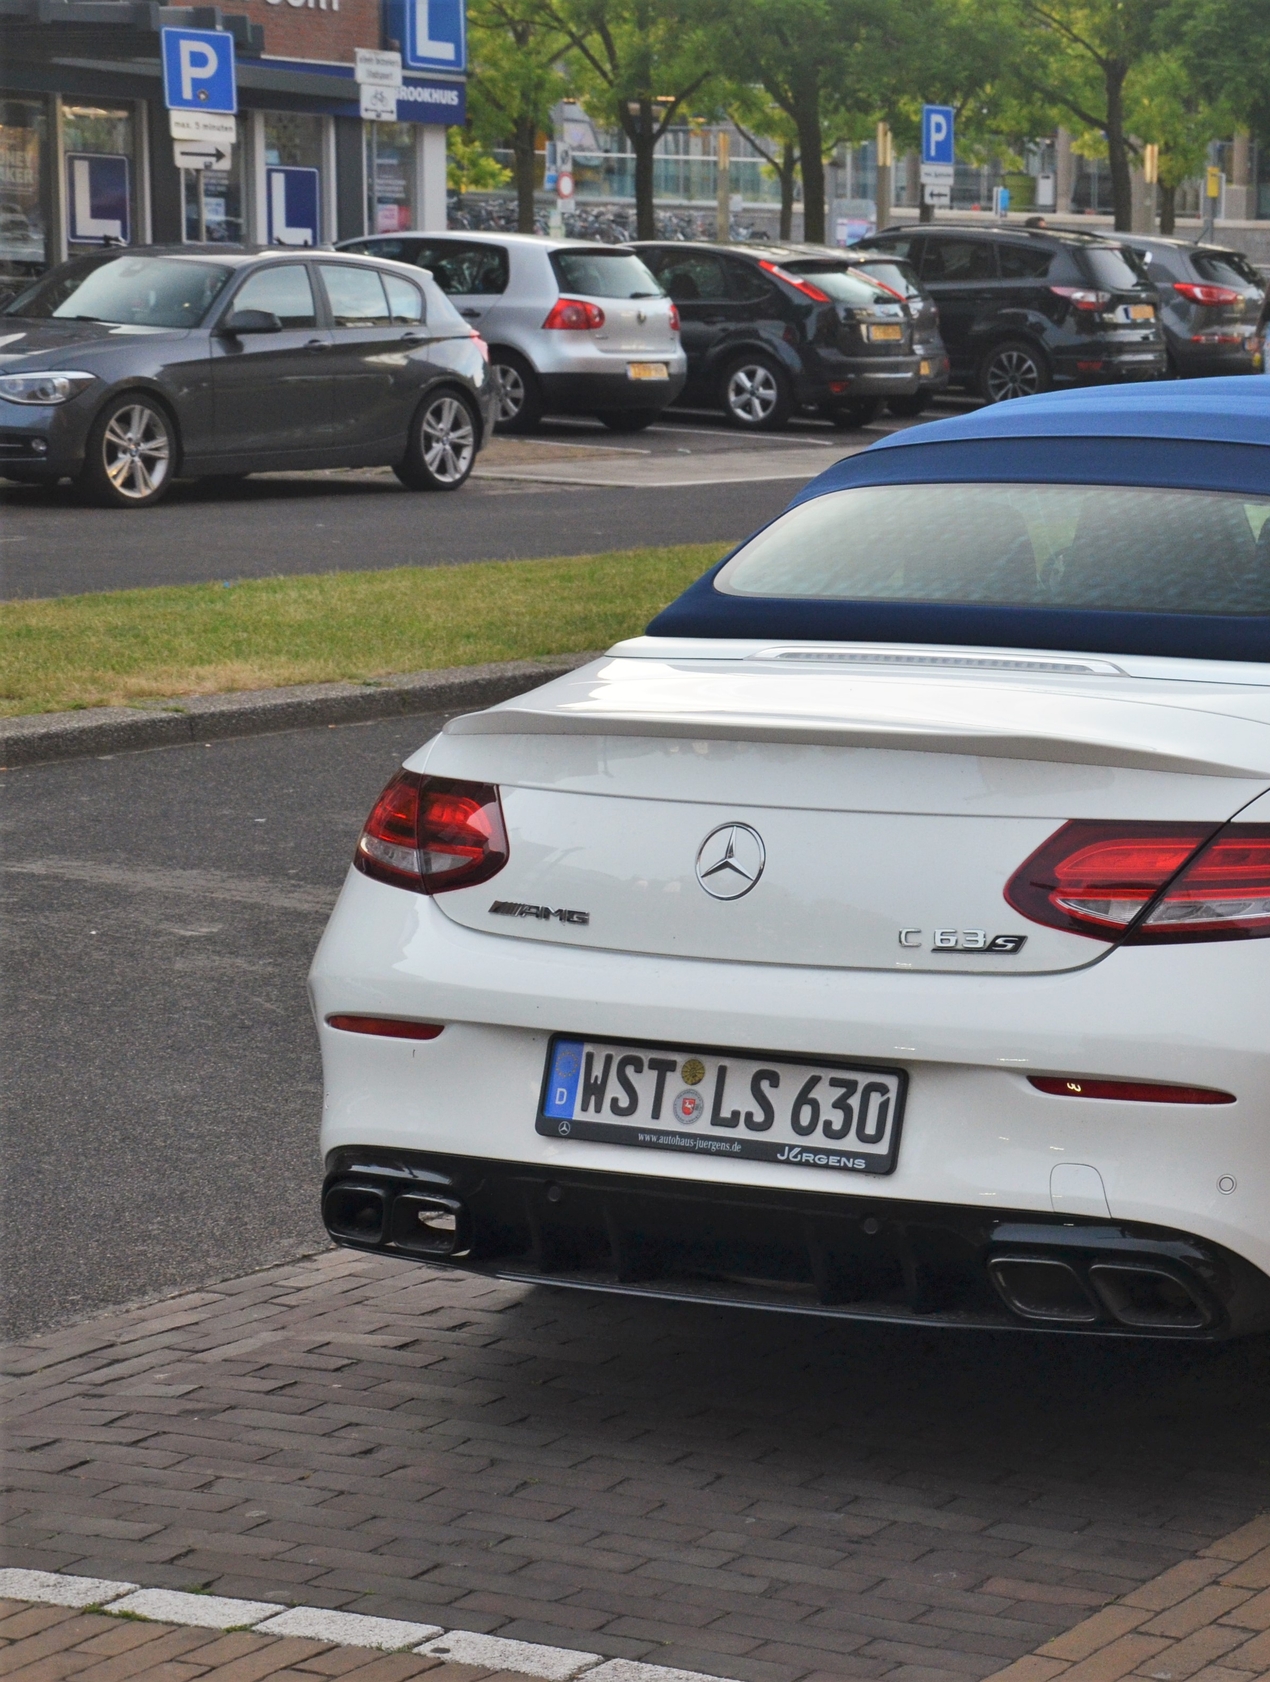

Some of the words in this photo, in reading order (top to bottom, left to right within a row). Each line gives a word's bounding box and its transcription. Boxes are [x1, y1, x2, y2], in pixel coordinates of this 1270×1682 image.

[178, 39, 219, 100] P
[397, 85, 459, 106] ROOKHUIS
[930, 113, 948, 157] P
[519, 902, 590, 926] AMG
[898, 928, 922, 948] C
[554, 1087, 568, 1106] D
[581, 1050, 678, 1120] WST
[710, 1064, 781, 1132] LS
[790, 1074, 891, 1145] 630
[638, 1132, 742, 1153] www.autohaus-juergens.de
